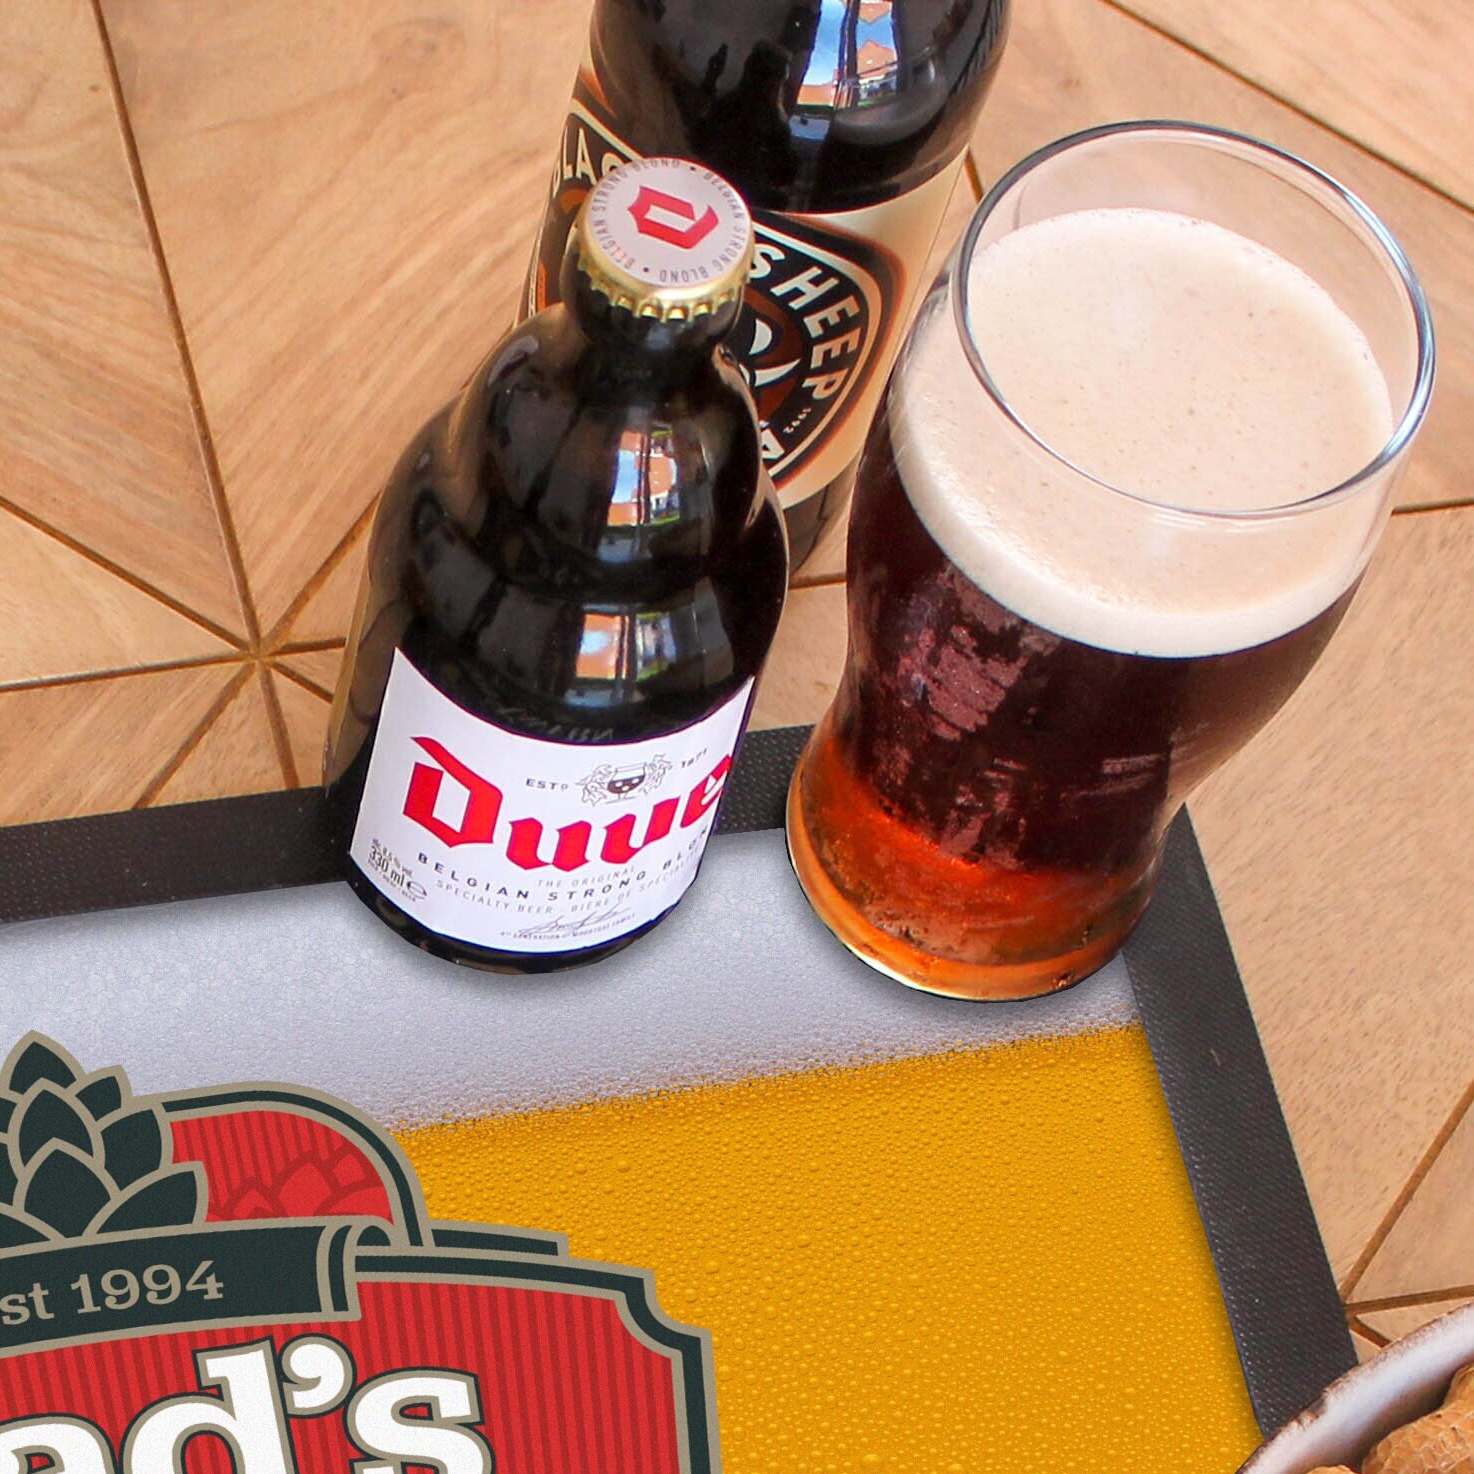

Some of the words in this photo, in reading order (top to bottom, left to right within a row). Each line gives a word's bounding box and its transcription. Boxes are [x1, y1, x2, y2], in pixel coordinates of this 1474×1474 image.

[591, 169, 628, 212] STRONG
[711, 226, 746, 271] STRONG
[659, 265, 709, 283] BLOND
[750, 243, 863, 400] SHEEP
[369, 845, 389, 872] 330
[390, 869, 405, 887] ml
[418, 852, 529, 899] BELGIAN
[547, 870, 647, 901] STRONG
[436, 880, 510, 910] SPECIALTY
[70, 1259, 226, 1314] 1994
